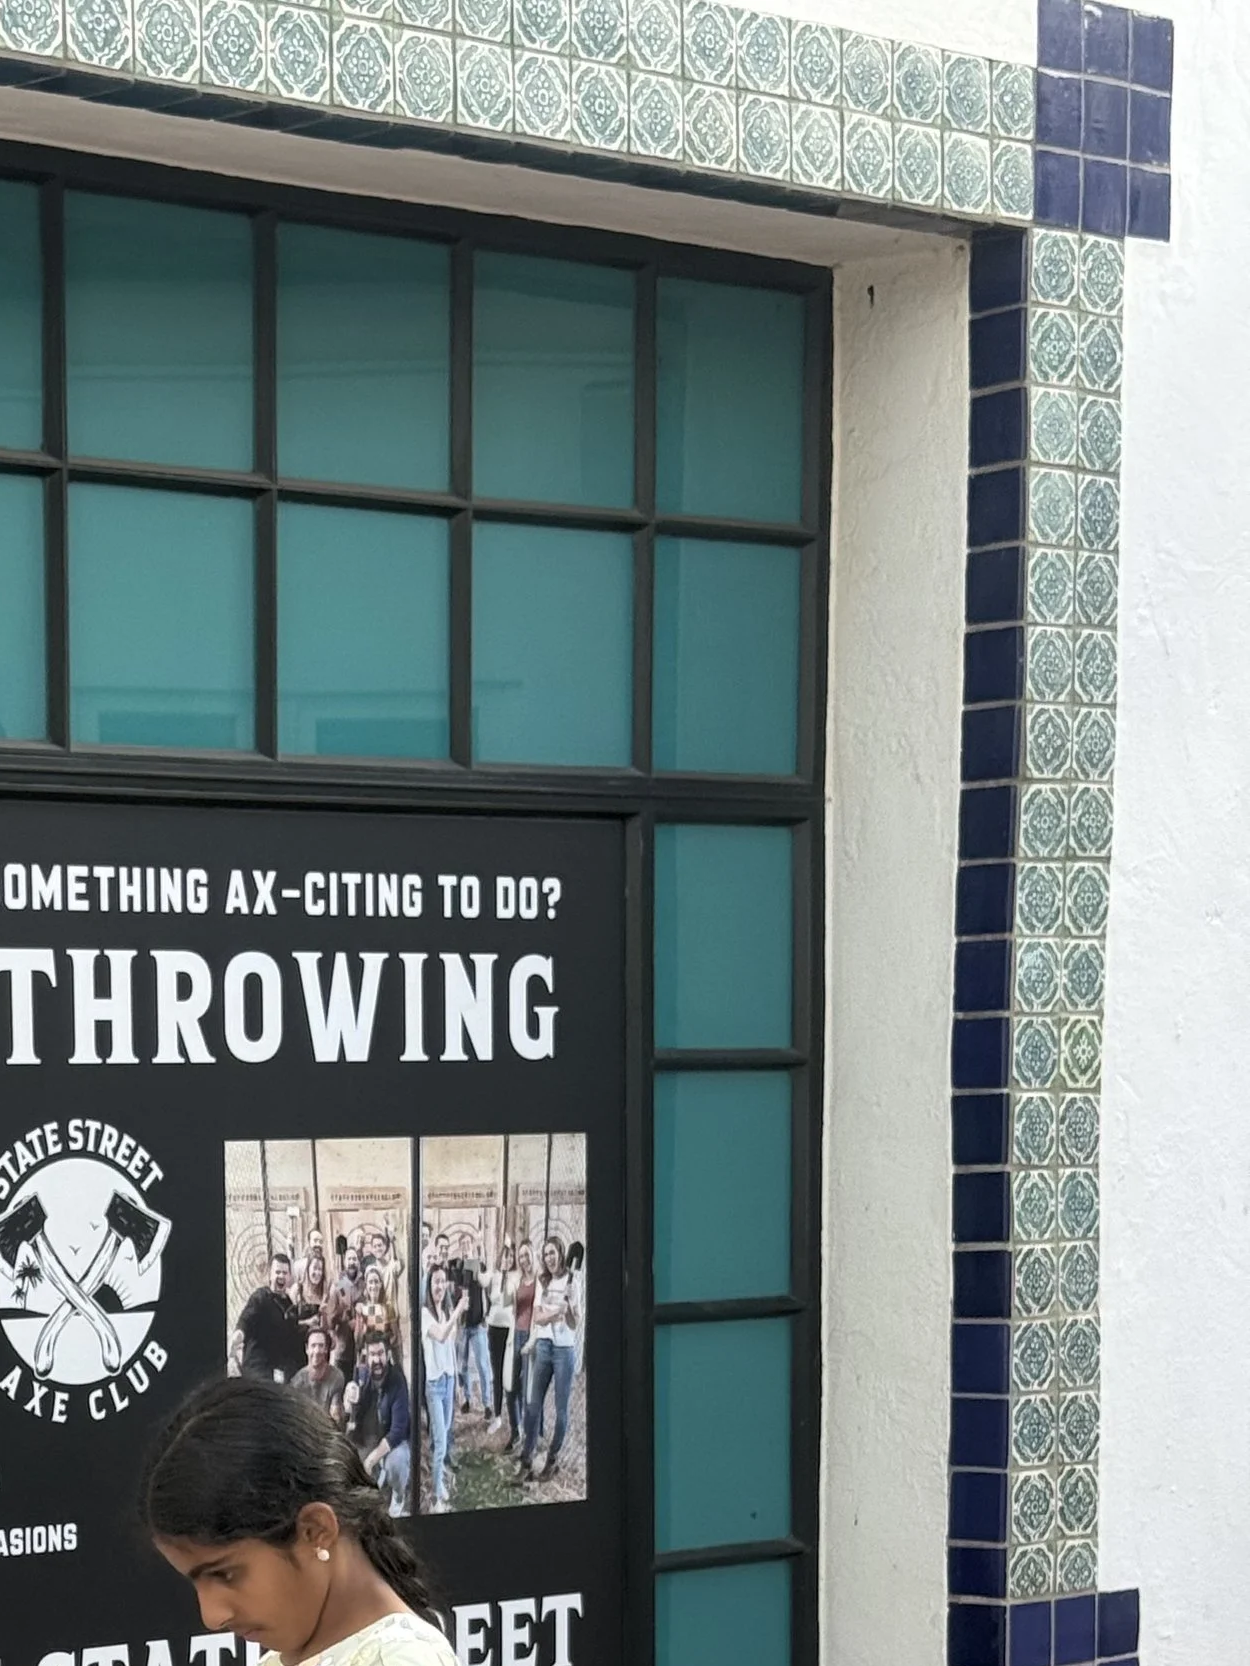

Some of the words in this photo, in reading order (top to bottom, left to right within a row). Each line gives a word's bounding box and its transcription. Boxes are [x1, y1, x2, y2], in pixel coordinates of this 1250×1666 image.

[225, 869, 423, 918] AX-CITING
[437, 874, 480, 919] TO
[496, 876, 561, 920] DO?
[68, 1119, 164, 1192] STREET
[89, 1340, 169, 1421] CLUB
